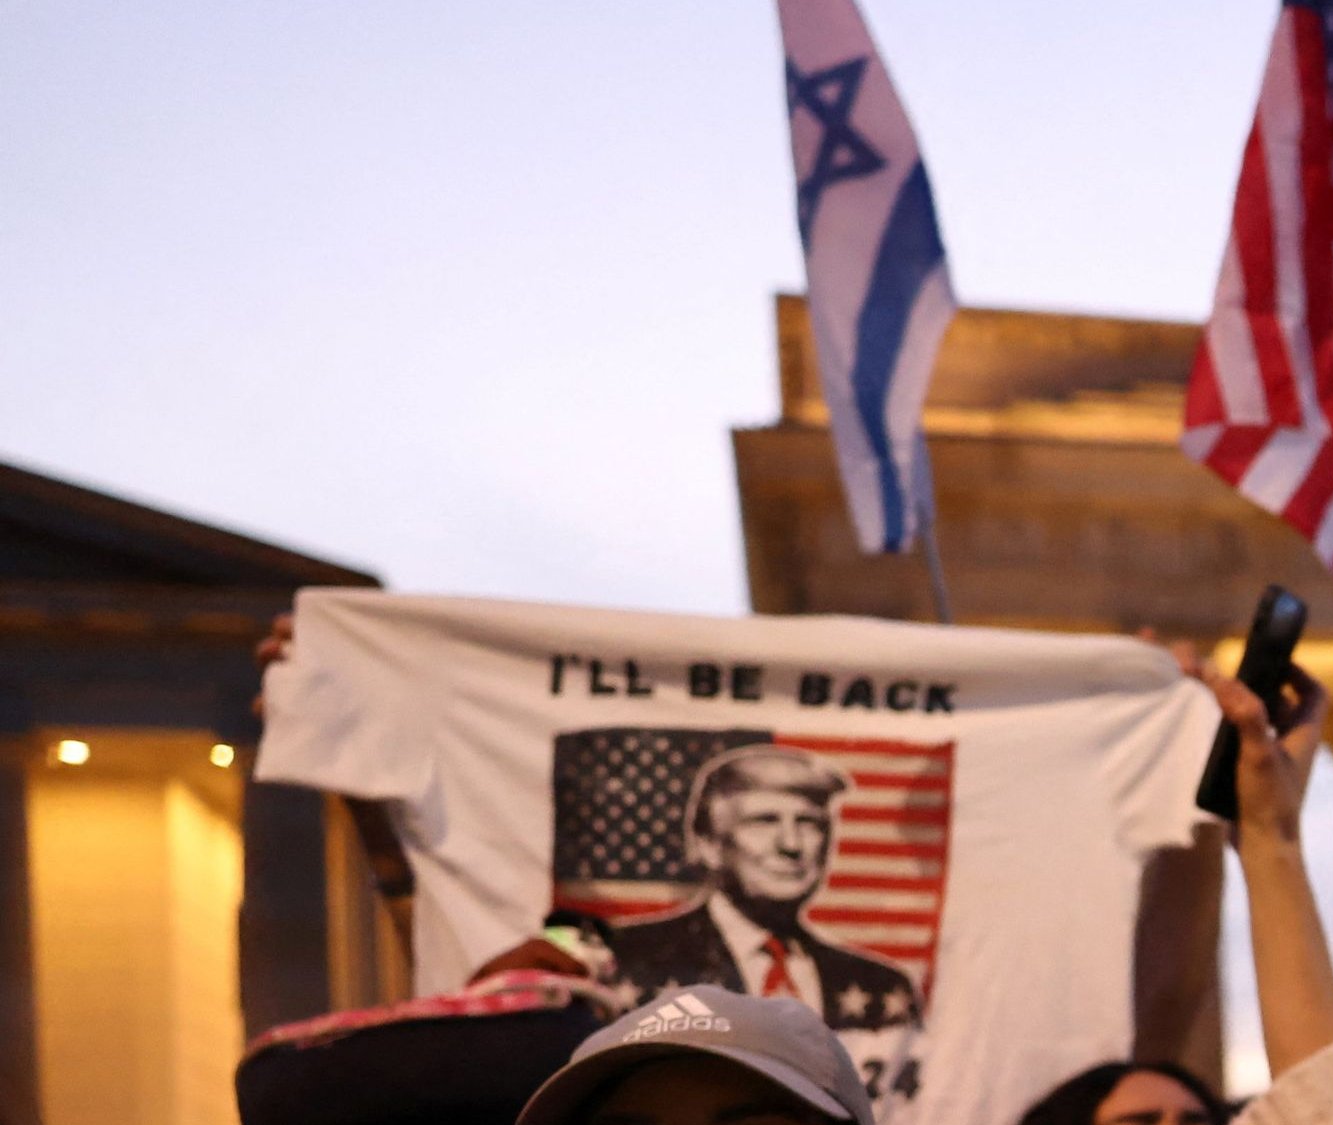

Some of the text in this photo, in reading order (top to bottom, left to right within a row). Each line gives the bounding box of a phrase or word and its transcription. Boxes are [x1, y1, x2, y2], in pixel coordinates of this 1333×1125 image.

[549, 654, 957, 714] I'LL BE BACK
[621, 1014, 732, 1043] adidas
